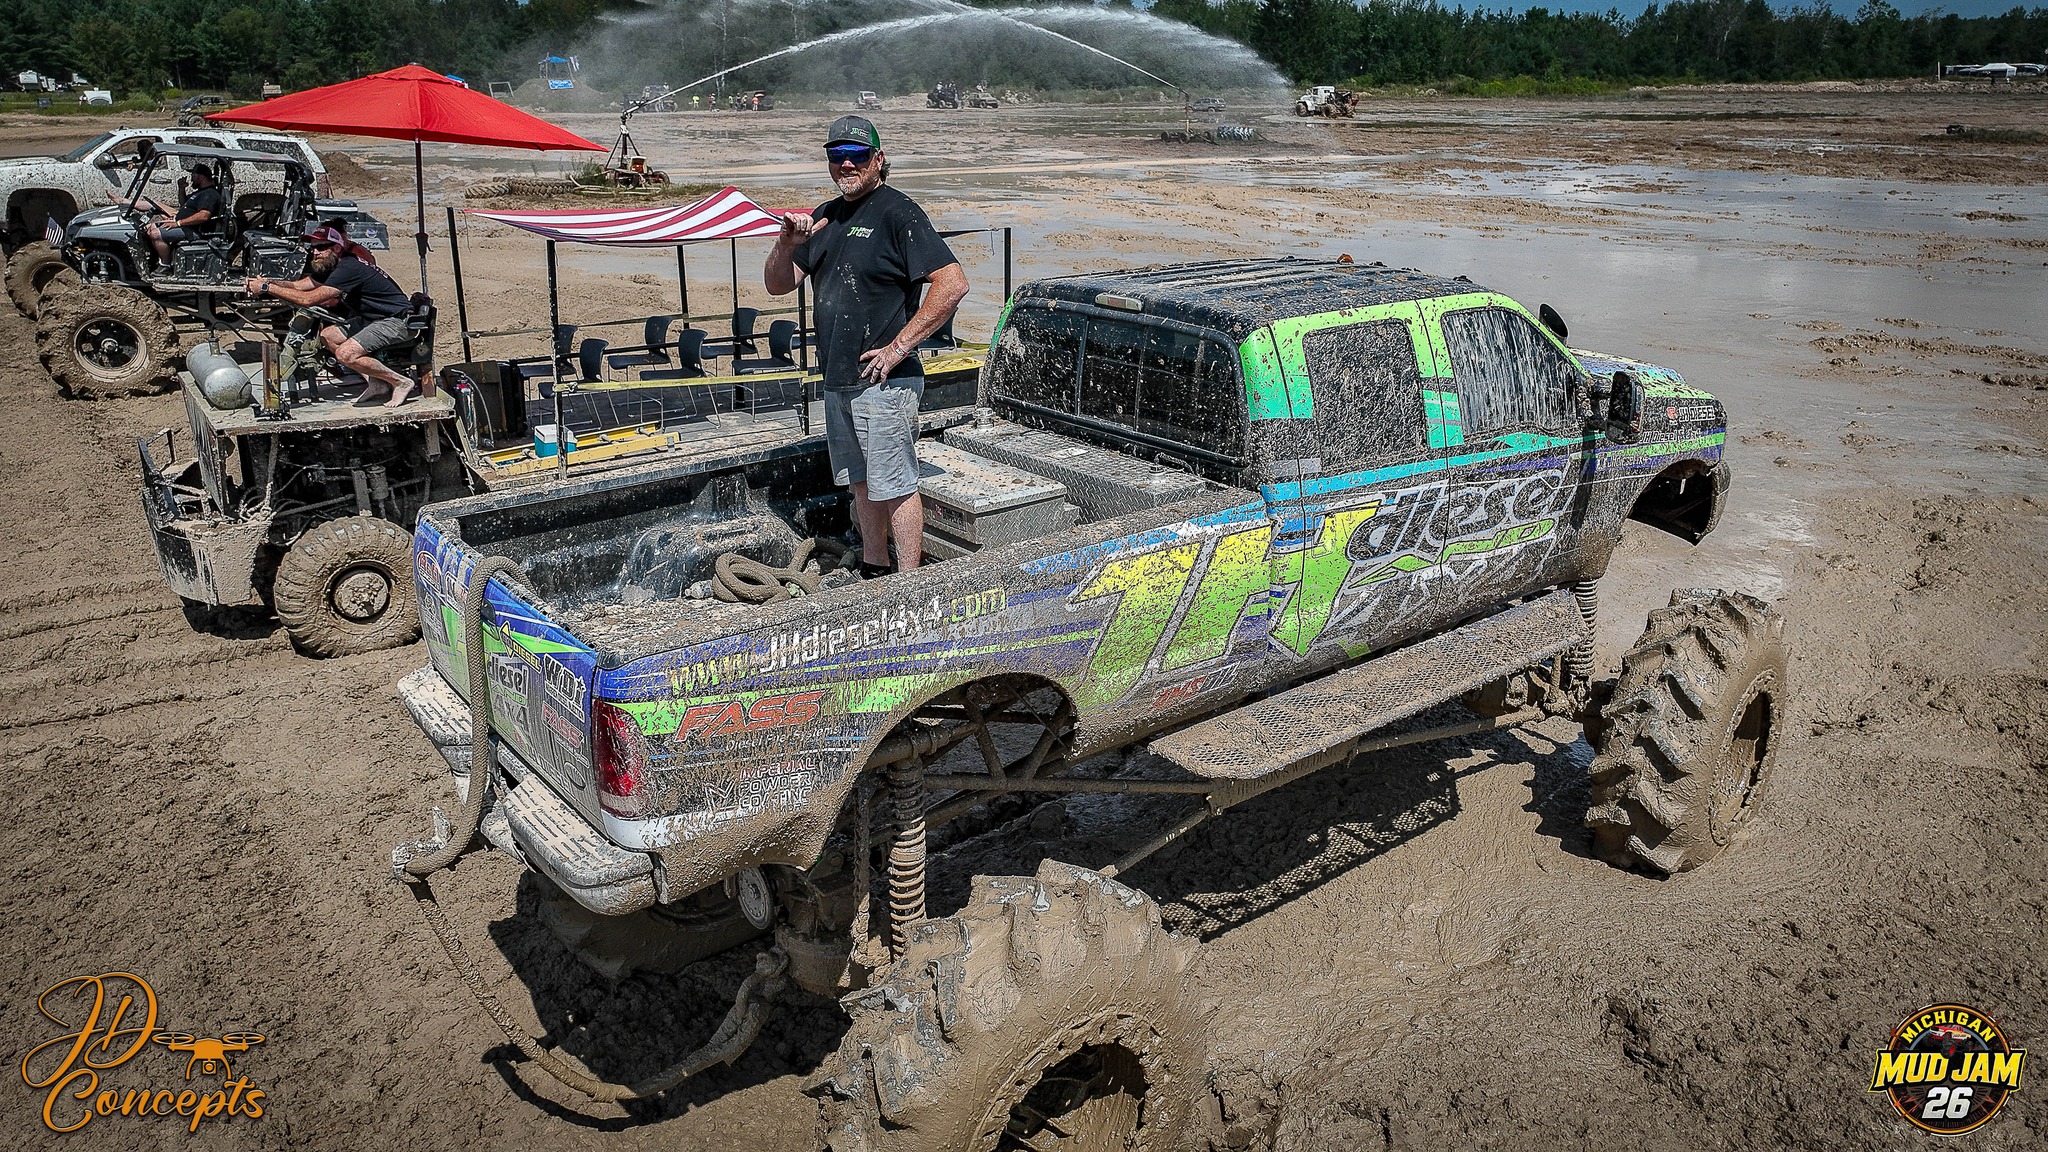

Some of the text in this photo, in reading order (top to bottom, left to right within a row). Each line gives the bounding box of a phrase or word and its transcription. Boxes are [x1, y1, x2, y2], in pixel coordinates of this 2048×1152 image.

[1689, 406, 1715, 421] DIESEL
[1347, 468, 1574, 562] diesel
[487, 655, 529, 698] diesel
[513, 642, 541, 670] DIESEL
[543, 704, 582, 748] FASS
[675, 689, 831, 743] FASS
[738, 772, 812, 797] POWDER
